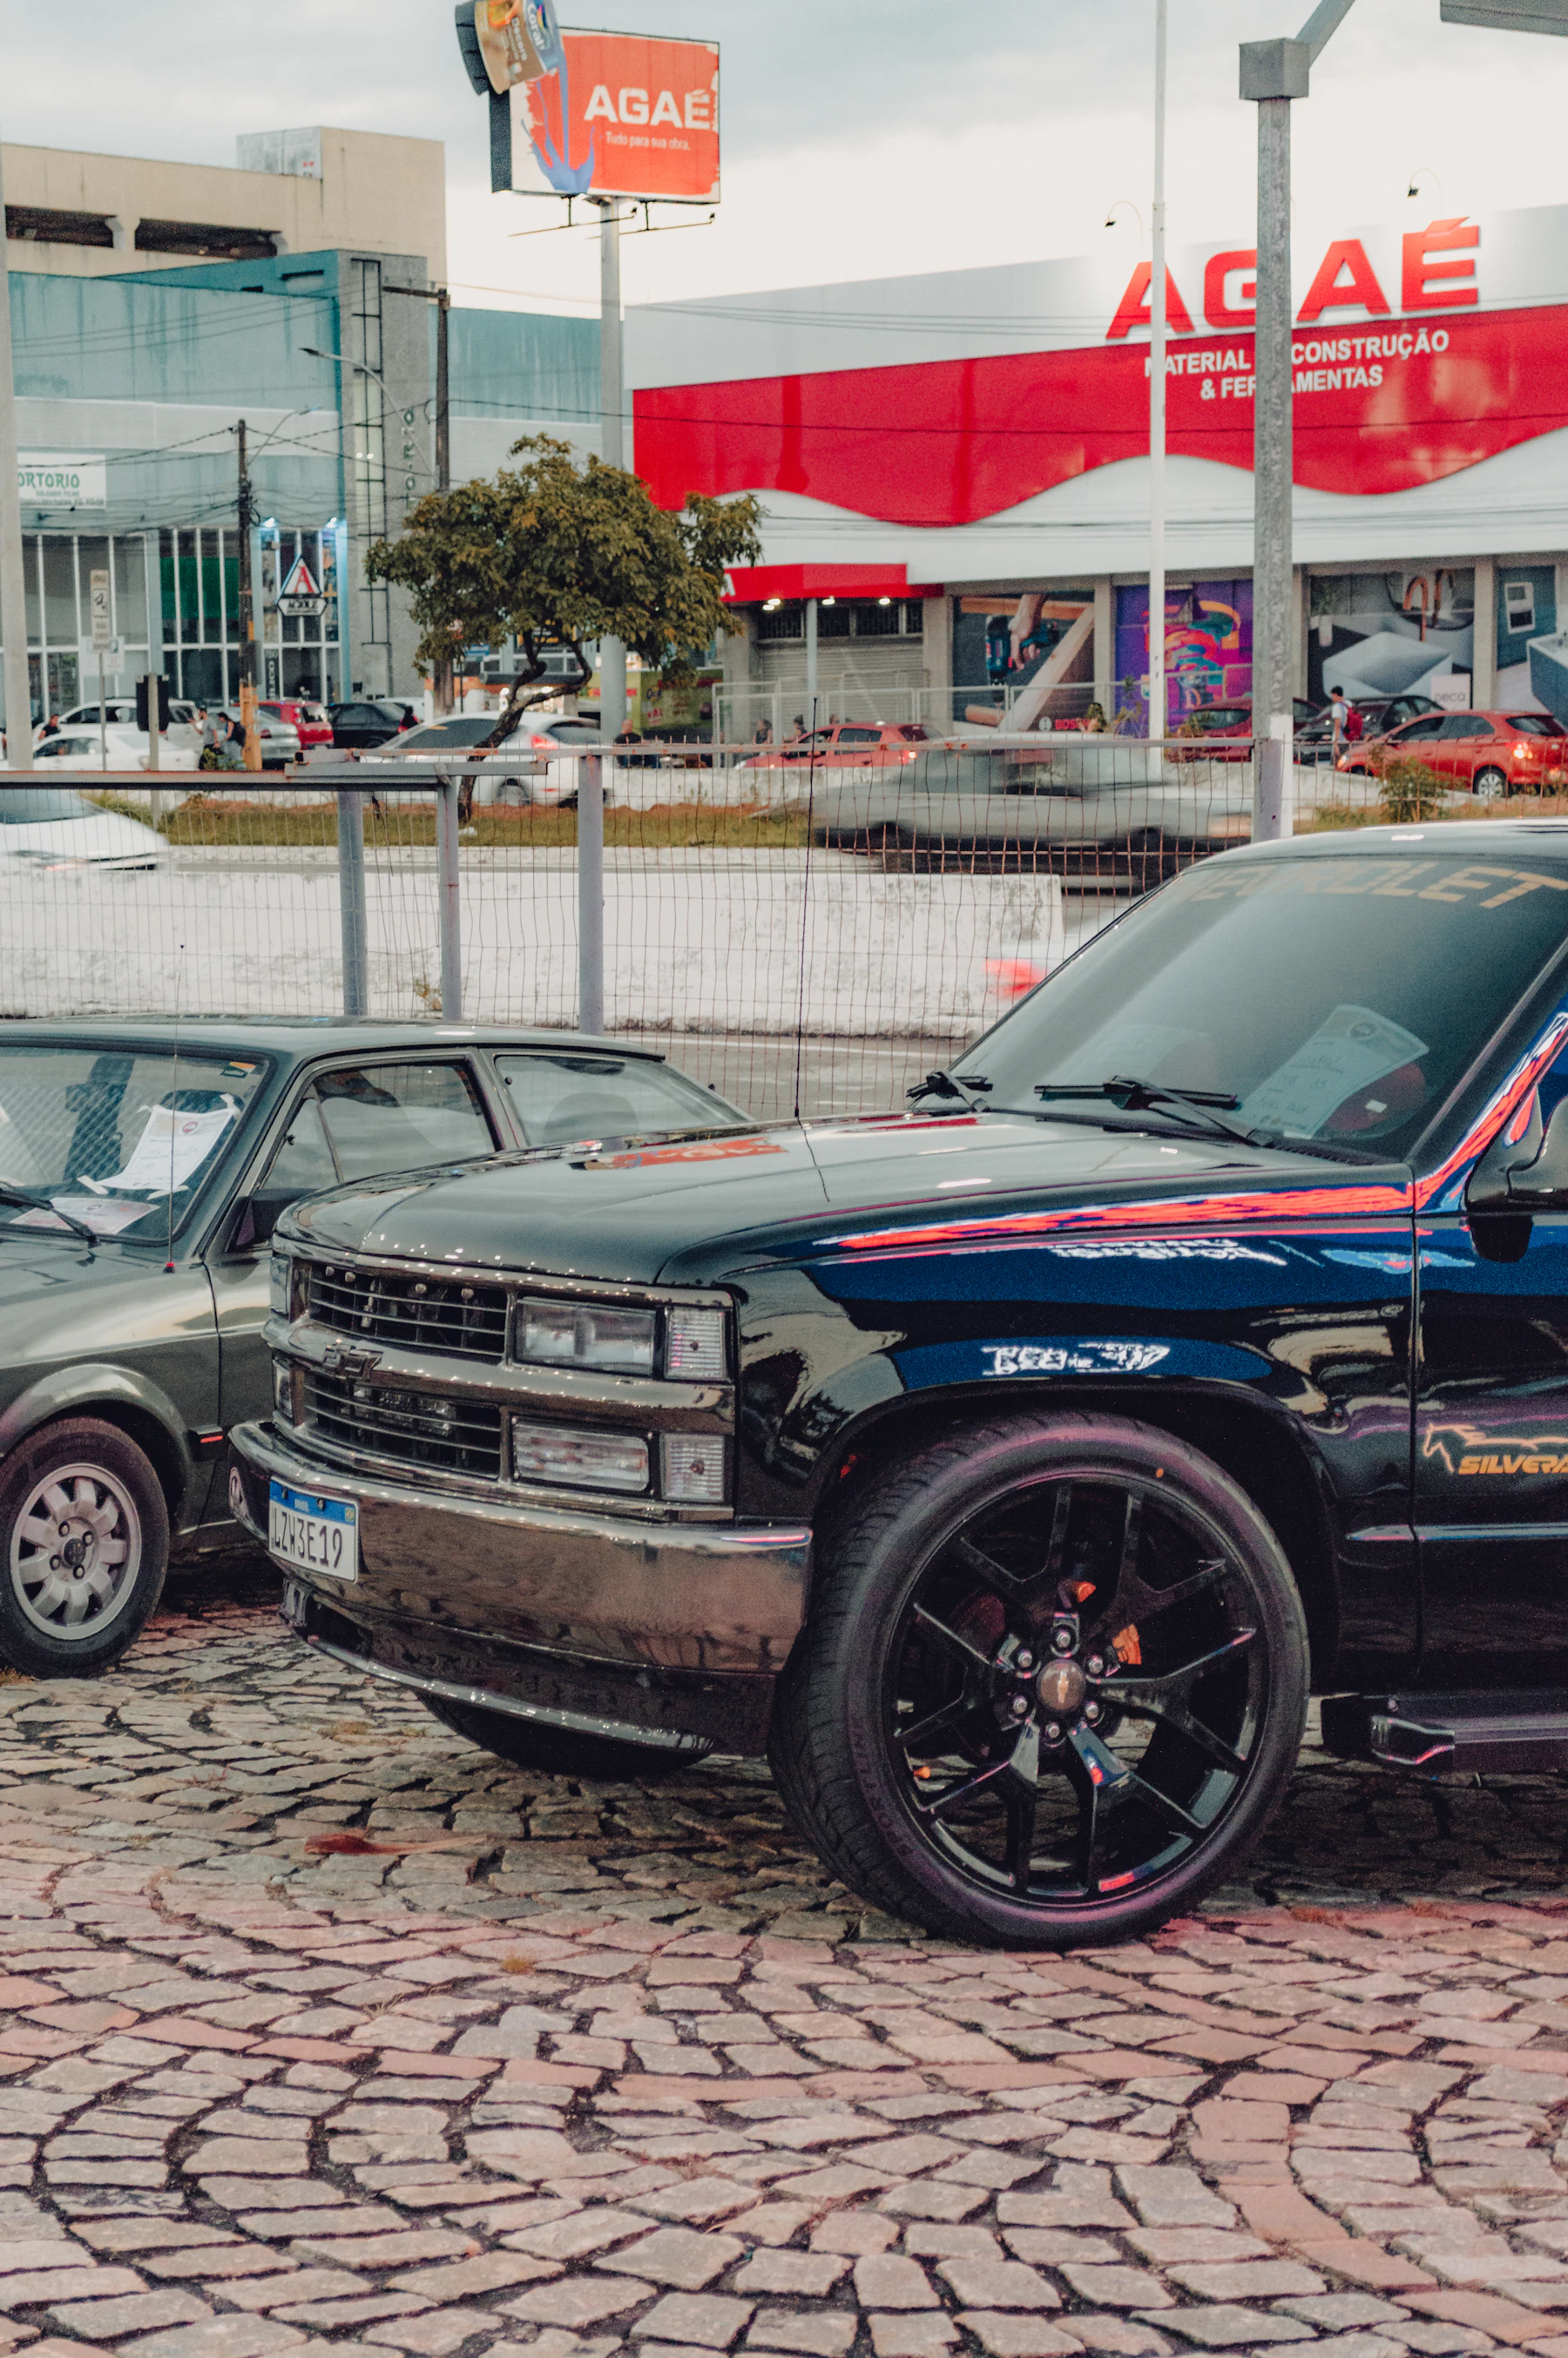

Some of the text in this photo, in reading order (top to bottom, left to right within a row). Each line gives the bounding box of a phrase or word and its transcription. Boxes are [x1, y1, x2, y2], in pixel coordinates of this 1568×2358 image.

[584, 84, 711, 130] AGAÉ
[606, 132, 628, 145] Tudo
[629, 133, 650, 149] para
[652, 139, 667, 149] sua
[1291, 328, 1450, 365] CONSTRUÇÃO
[1200, 378, 1216, 400] &
[274, 1507, 343, 1569] LZW3E19
